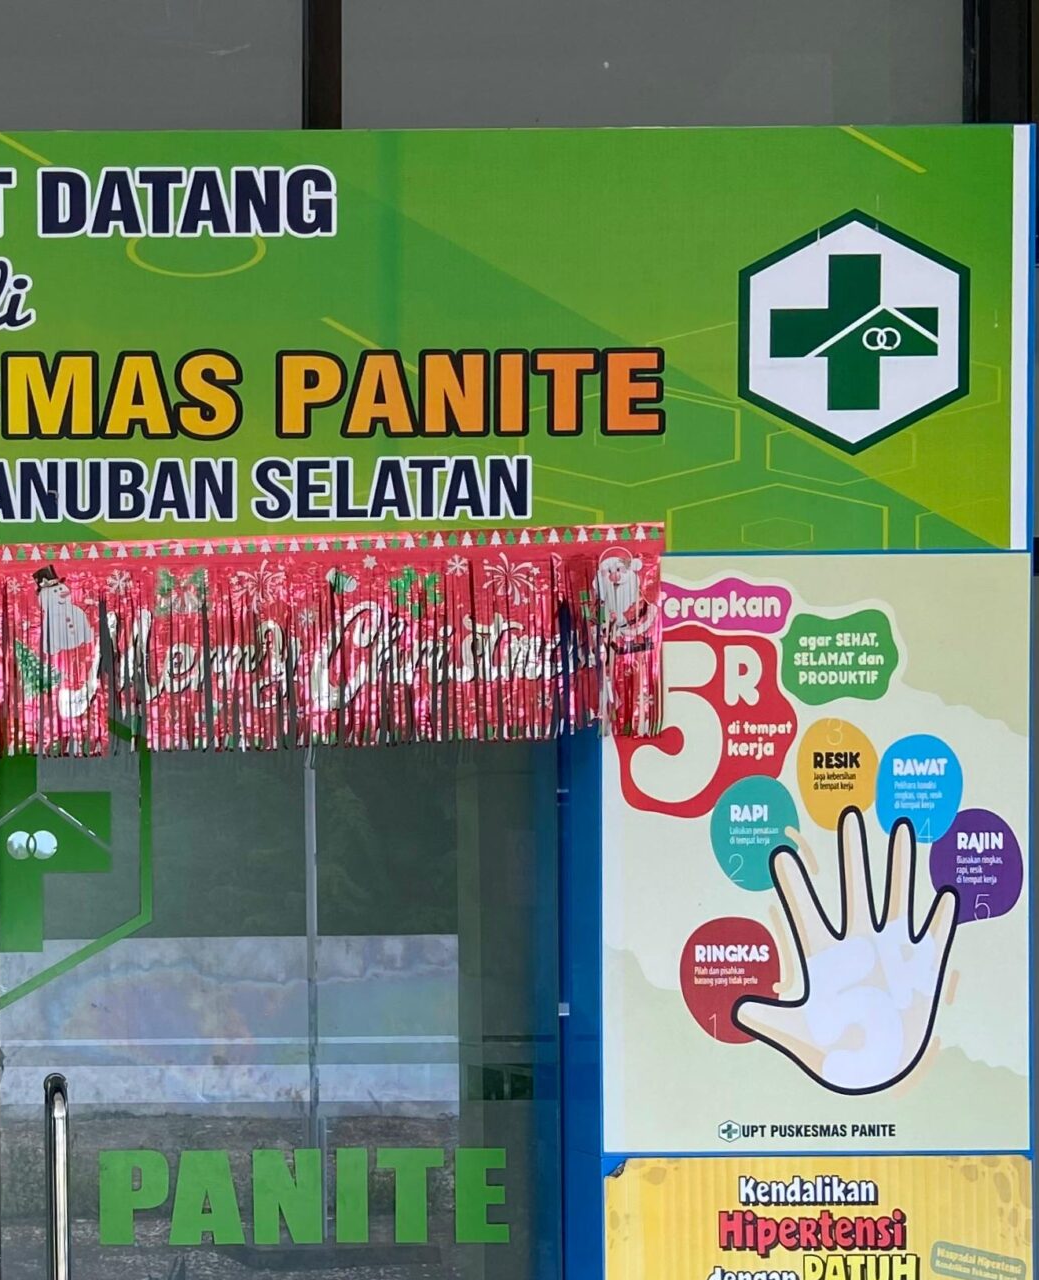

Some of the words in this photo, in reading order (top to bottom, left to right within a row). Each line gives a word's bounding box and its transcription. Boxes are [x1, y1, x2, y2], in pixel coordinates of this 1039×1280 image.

[37, 166, 336, 237] DATANG
[275, 347, 664, 438] PANITE
[252, 455, 532, 520] SELATAN
[799, 635, 832, 650] agar
[836, 632, 879, 648] SEHAT,
[794, 652, 855, 666] SELAMAT
[858, 652, 884, 666] dan
[798, 671, 879, 685] PRODUKTIF
[727, 720, 741, 735] di
[743, 721, 792, 737] tempat
[727, 737, 775, 760] kerja
[813, 751, 861, 769] RESIK
[893, 758, 948, 776] RAWAT
[820, 782, 839, 792] tempat
[730, 804, 768, 822] RAPI
[918, 817, 934, 843] 4
[957, 832, 1004, 854] RAJIN
[729, 853, 744, 882] 2
[974, 893, 991, 921] 5
[695, 944, 770, 963] RINGKAS
[742, 1125, 767, 1138] UPT
[771, 1124, 847, 1137] PUSKESMAS
[851, 1124, 896, 1137] PANITE
[99, 1147, 510, 1246] PANITE
[738, 1175, 878, 1205] Kendalikan
[718, 1208, 907, 1258] Hipertensi
